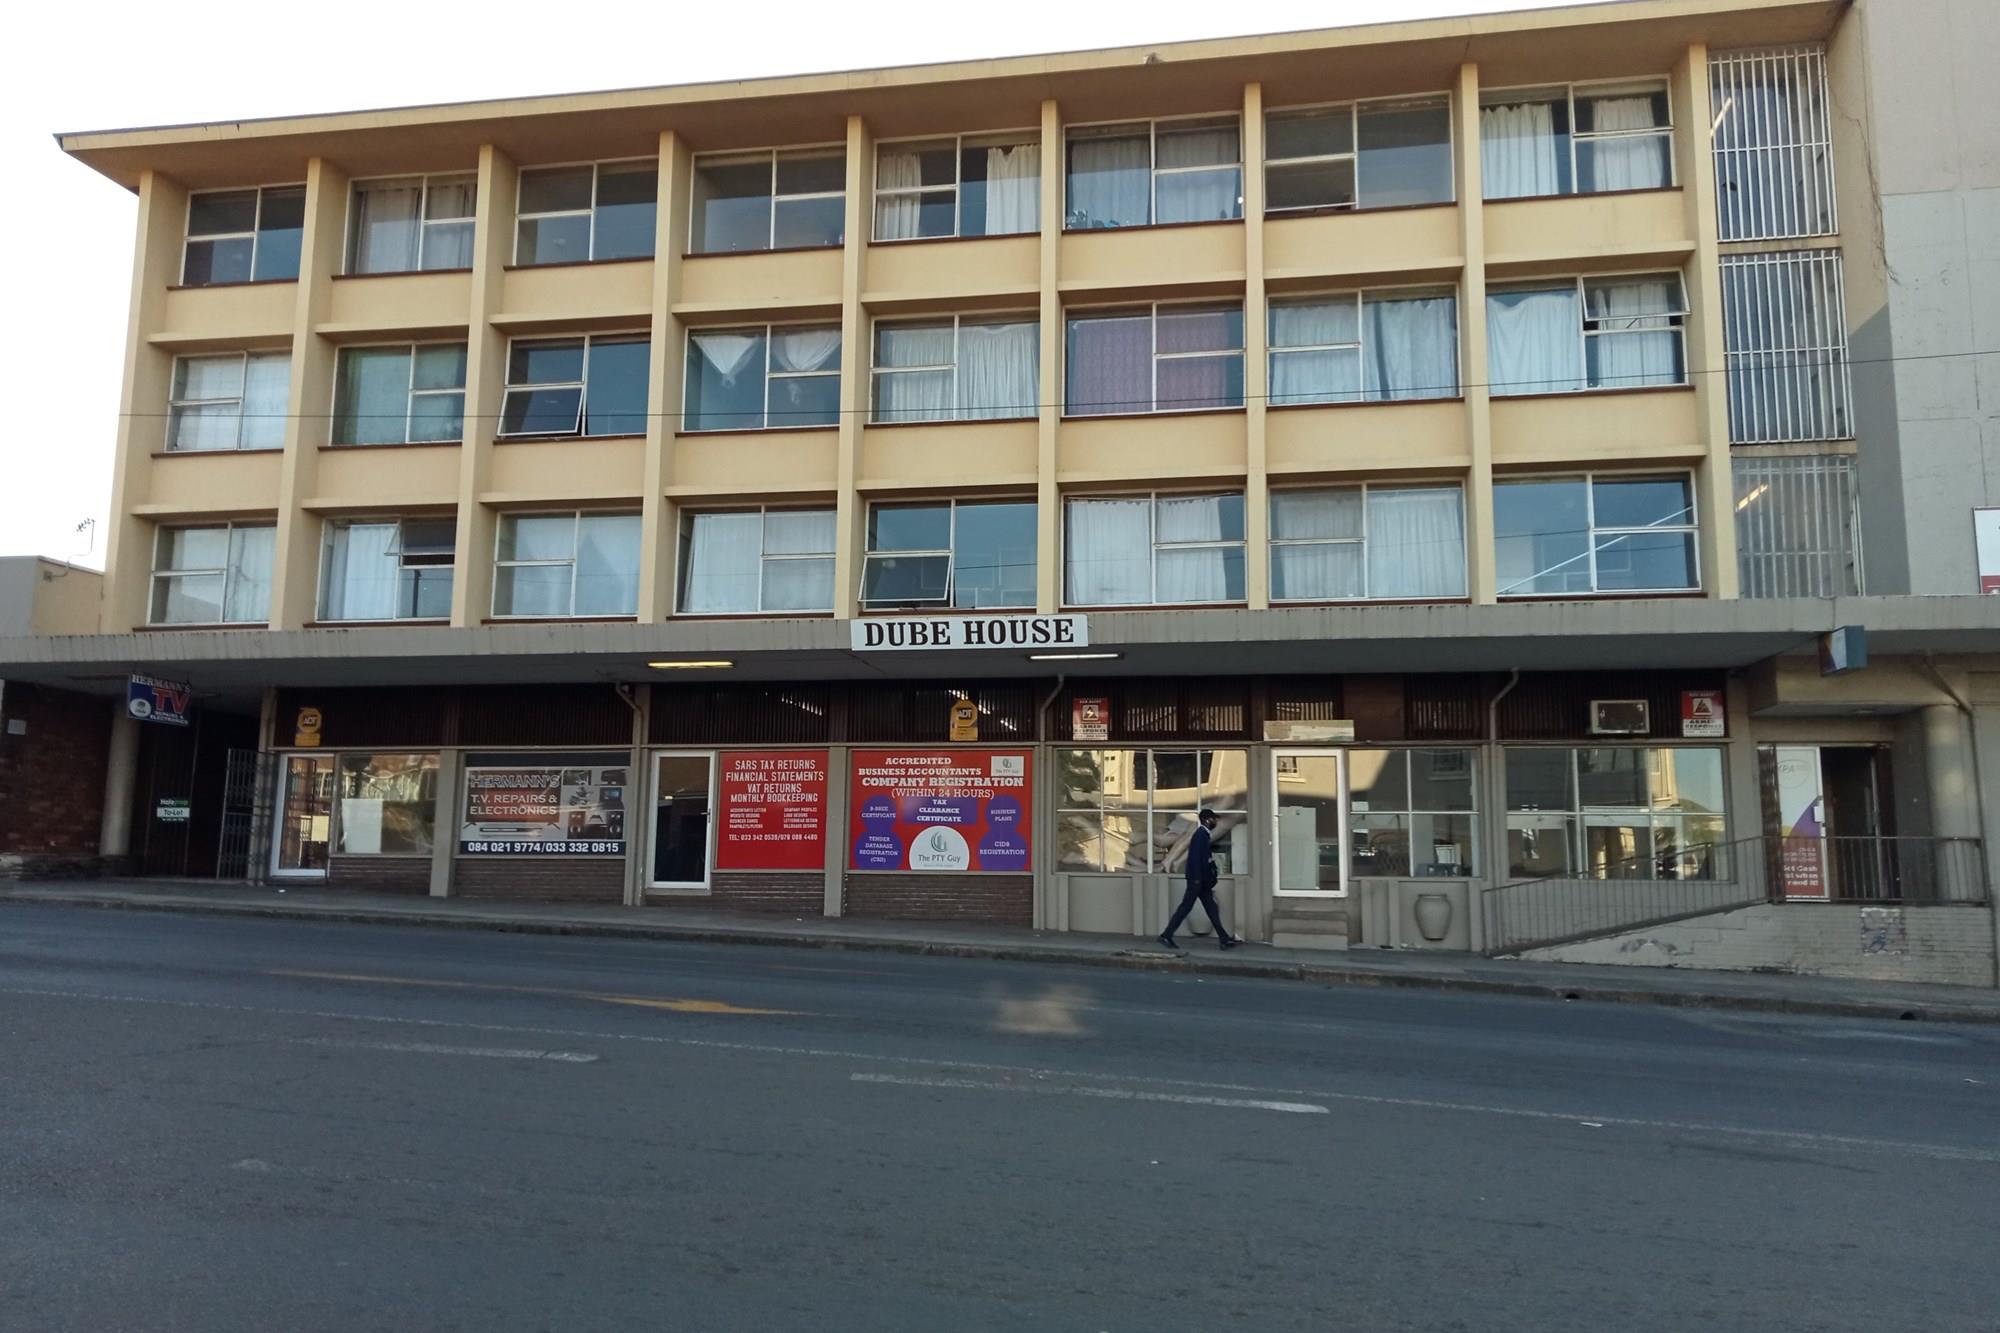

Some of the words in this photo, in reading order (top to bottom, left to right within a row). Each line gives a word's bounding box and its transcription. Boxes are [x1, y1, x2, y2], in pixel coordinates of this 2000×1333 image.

[864, 621, 951, 647] DUBE
[962, 618, 1074, 645] HOUSE
[152, 687, 190, 714] TV
[735, 759, 757, 770] SARS
[760, 759, 775, 770] TAX
[777, 759, 816, 770] RETURNS
[885, 757, 952, 765] ACCREDITED
[725, 771, 769, 782] FINANCIAL
[771, 771, 825, 781] STATEMENTS
[858, 768, 906, 776] BUSINESS
[907, 767, 982, 776] ACCOUNTANTS
[470, 774, 561, 789] HERMANN'S
[862, 777, 926, 787] COMPANY
[928, 777, 1024, 787] REGISTRATION
[747, 783, 761, 793] VAT
[763, 783, 802, 793] RETURNS
[471, 794, 491, 803] T.V.
[494, 794, 546, 803] REPAIRS
[548, 794, 558, 803] &
[730, 794, 765, 803] MONTHLY
[767, 793, 818, 803] BOOKKEEPING
[891, 788, 936, 799] (WITHIN
[938, 789, 951, 797] 24
[953, 788, 995, 800] HOURS)
[469, 805, 557, 815] ELECTRONICS
[468, 842, 488, 853] 084
[490, 842, 511, 853] 021
[514, 842, 566, 853] 9774/033
[568, 842, 589, 853] 332
[591, 842, 619, 853] 0815
[918, 854, 930, 862] The
[931, 854, 945, 862] PTY
[946, 854, 961, 863] Guy
